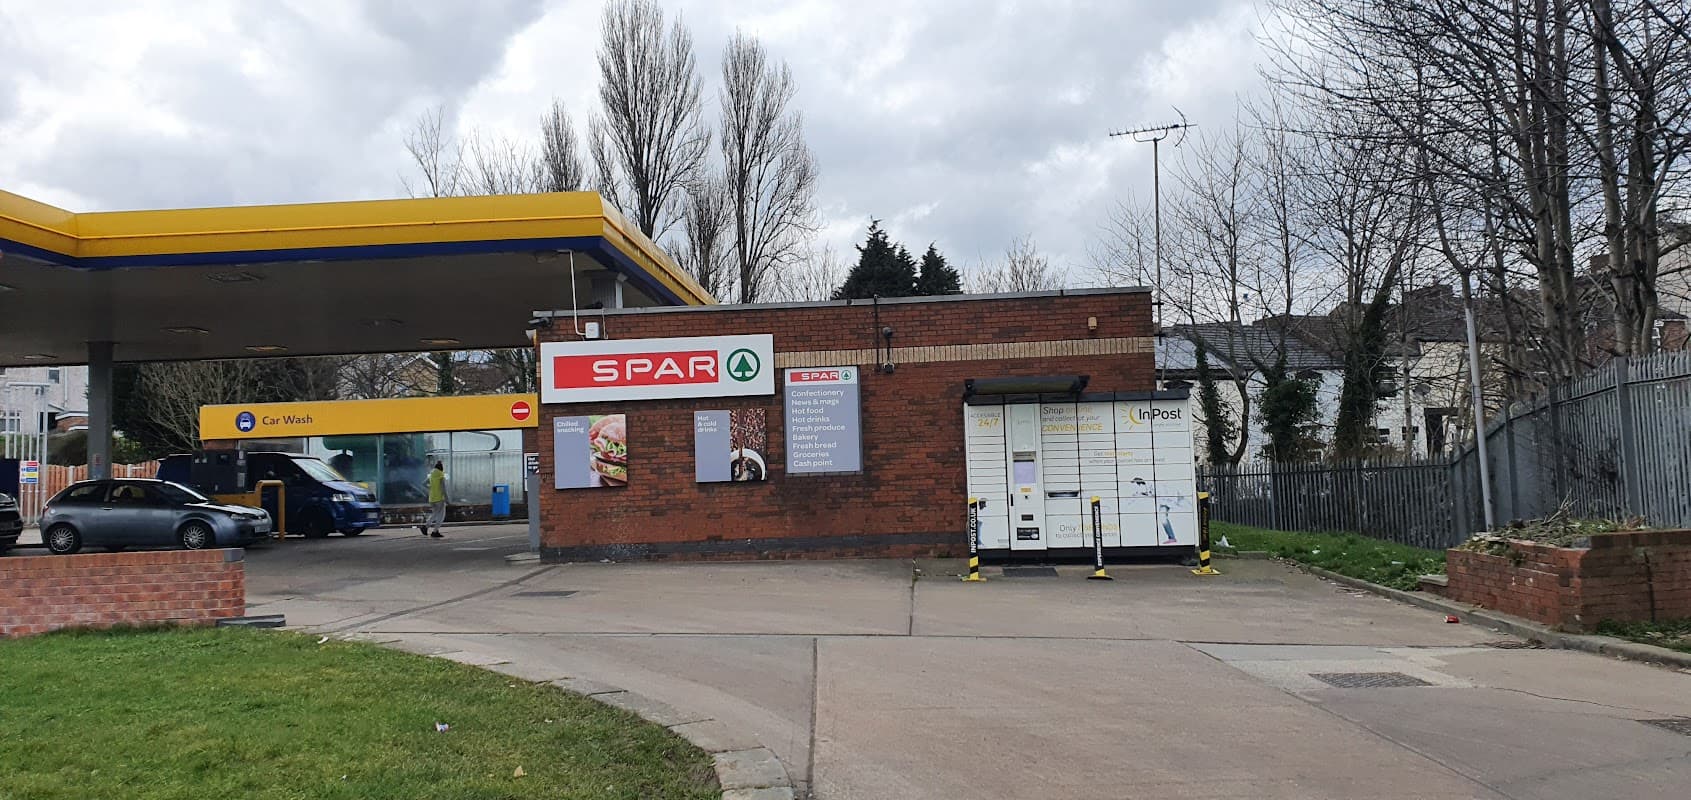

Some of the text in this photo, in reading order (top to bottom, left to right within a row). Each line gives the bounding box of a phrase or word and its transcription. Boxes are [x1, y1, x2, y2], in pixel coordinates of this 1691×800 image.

[592, 355, 715, 382] SPAR
[801, 371, 839, 380] SPAR
[791, 389, 844, 398] Confectionery
[820, 399, 839, 407] mags
[1043, 406, 1064, 416] Shop
[1139, 407, 1181, 420] InPost
[262, 414, 313, 426] Car Wash
[977, 418, 998, 428] 24/7
[814, 424, 846, 433] produce
[1041, 424, 1103, 433] CONVENIENCE
[793, 434, 819, 442] Bakery
[813, 459, 833, 467] point
